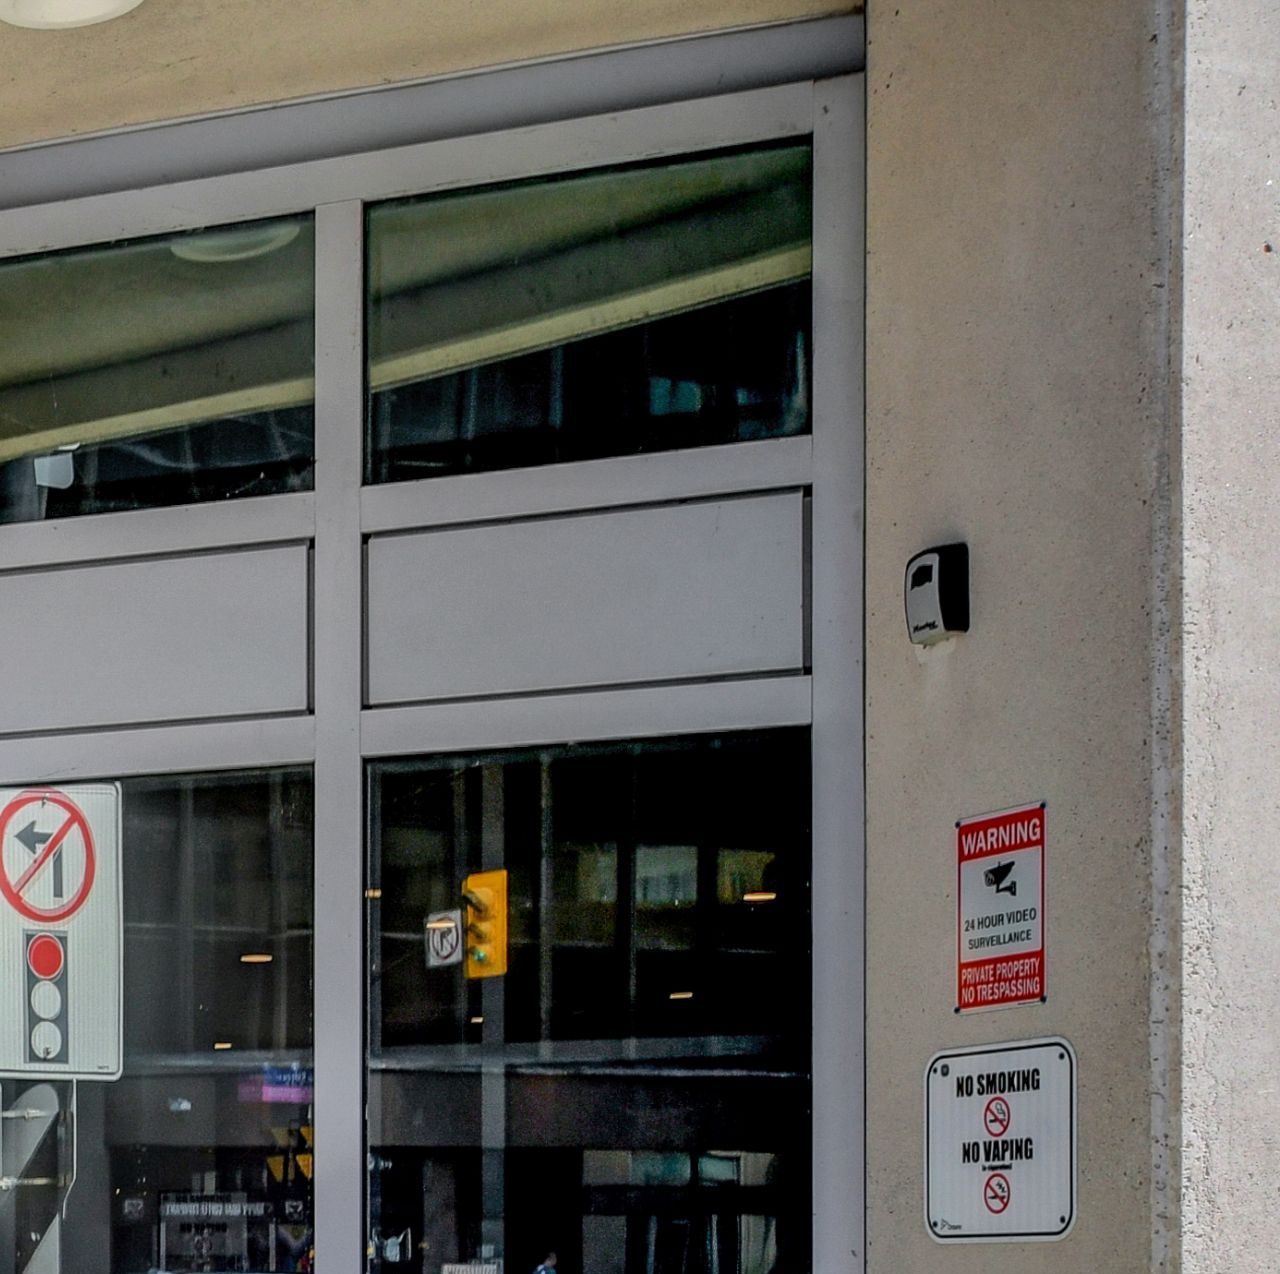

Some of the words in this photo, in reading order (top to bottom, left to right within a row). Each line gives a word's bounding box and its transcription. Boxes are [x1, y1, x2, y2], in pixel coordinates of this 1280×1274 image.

[962, 818, 1040, 856] WARNING
[964, 918, 976, 932] 24
[977, 913, 1004, 929] HOUR
[1006, 907, 1037, 925] VIDEO
[968, 929, 1032, 950] SURVEILLANCE
[961, 964, 994, 985] PRIVATE
[996, 957, 1040, 979] PROPERTY
[962, 986, 976, 1004] NO
[977, 976, 1040, 1000] TRESPASSING
[956, 1075, 974, 1098] NO
[977, 1068, 1040, 1096] SMOKING
[962, 1141, 980, 1164] NO
[983, 1138, 1033, 1162] VAPING
